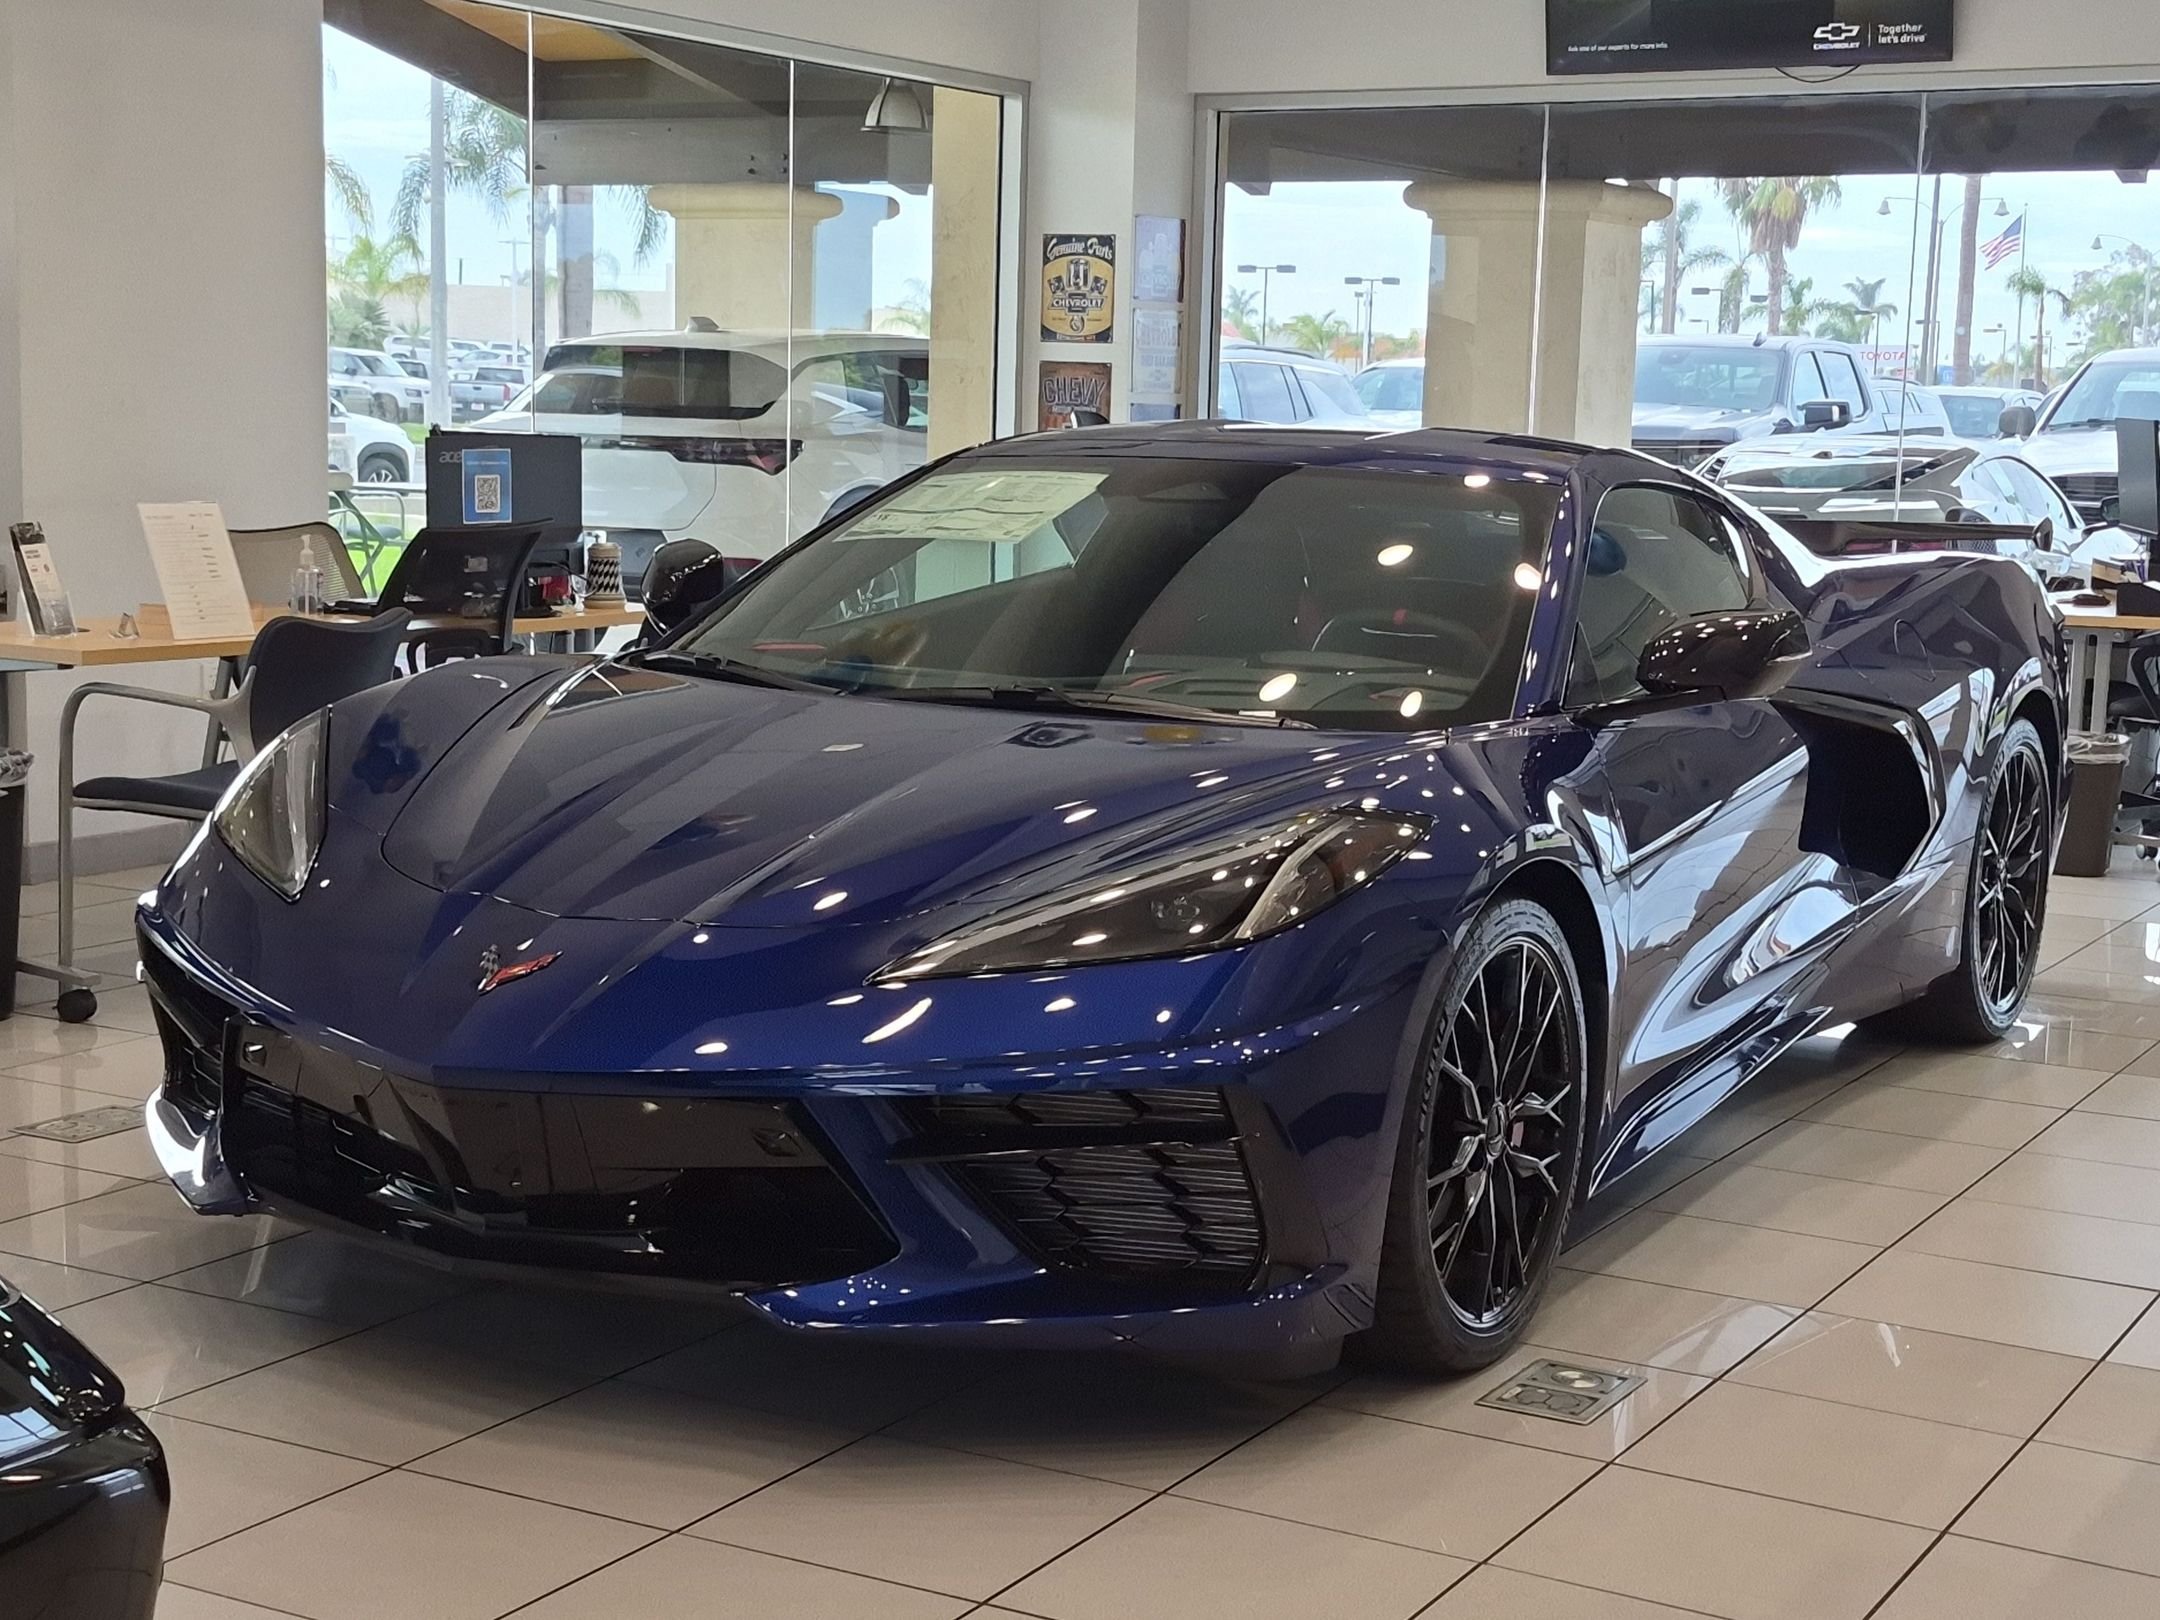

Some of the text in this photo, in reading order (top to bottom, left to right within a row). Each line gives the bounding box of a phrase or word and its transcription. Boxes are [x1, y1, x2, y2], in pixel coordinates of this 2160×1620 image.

[1878, 24, 1922, 35] Together
[1878, 33, 1925, 44] let's drive
[1046, 237, 1113, 260] Genuine Parts
[1053, 298, 1102, 308] CHEVROLET
[1860, 351, 1907, 361] TOYOTA
[1043, 375, 1107, 407] CHEVY
[439, 451, 462, 464] ace
